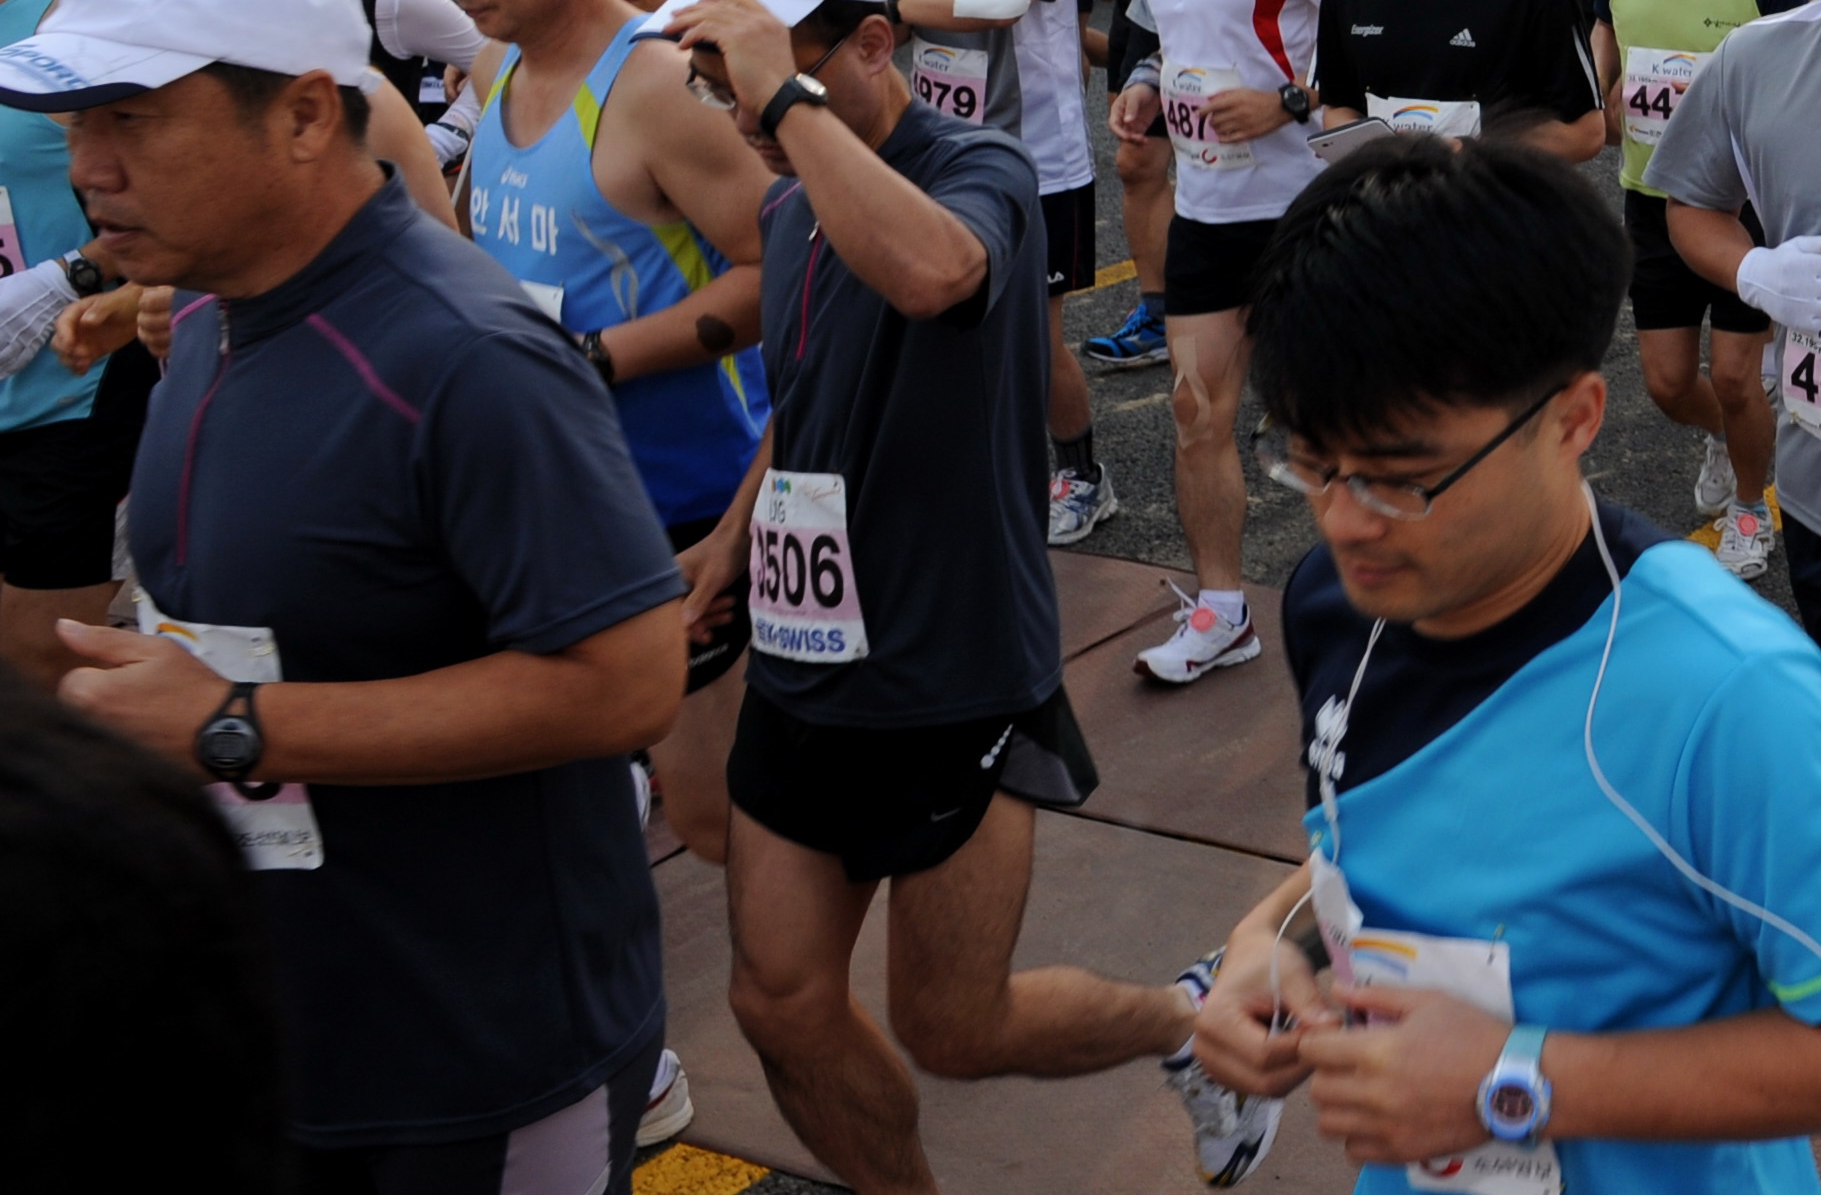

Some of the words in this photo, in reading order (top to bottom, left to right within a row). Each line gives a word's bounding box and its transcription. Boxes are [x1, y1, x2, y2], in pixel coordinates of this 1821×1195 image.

[1351, 24, 1384, 37] Energizer
[1449, 38, 1476, 48] adidas
[1662, 65, 1693, 77] water
